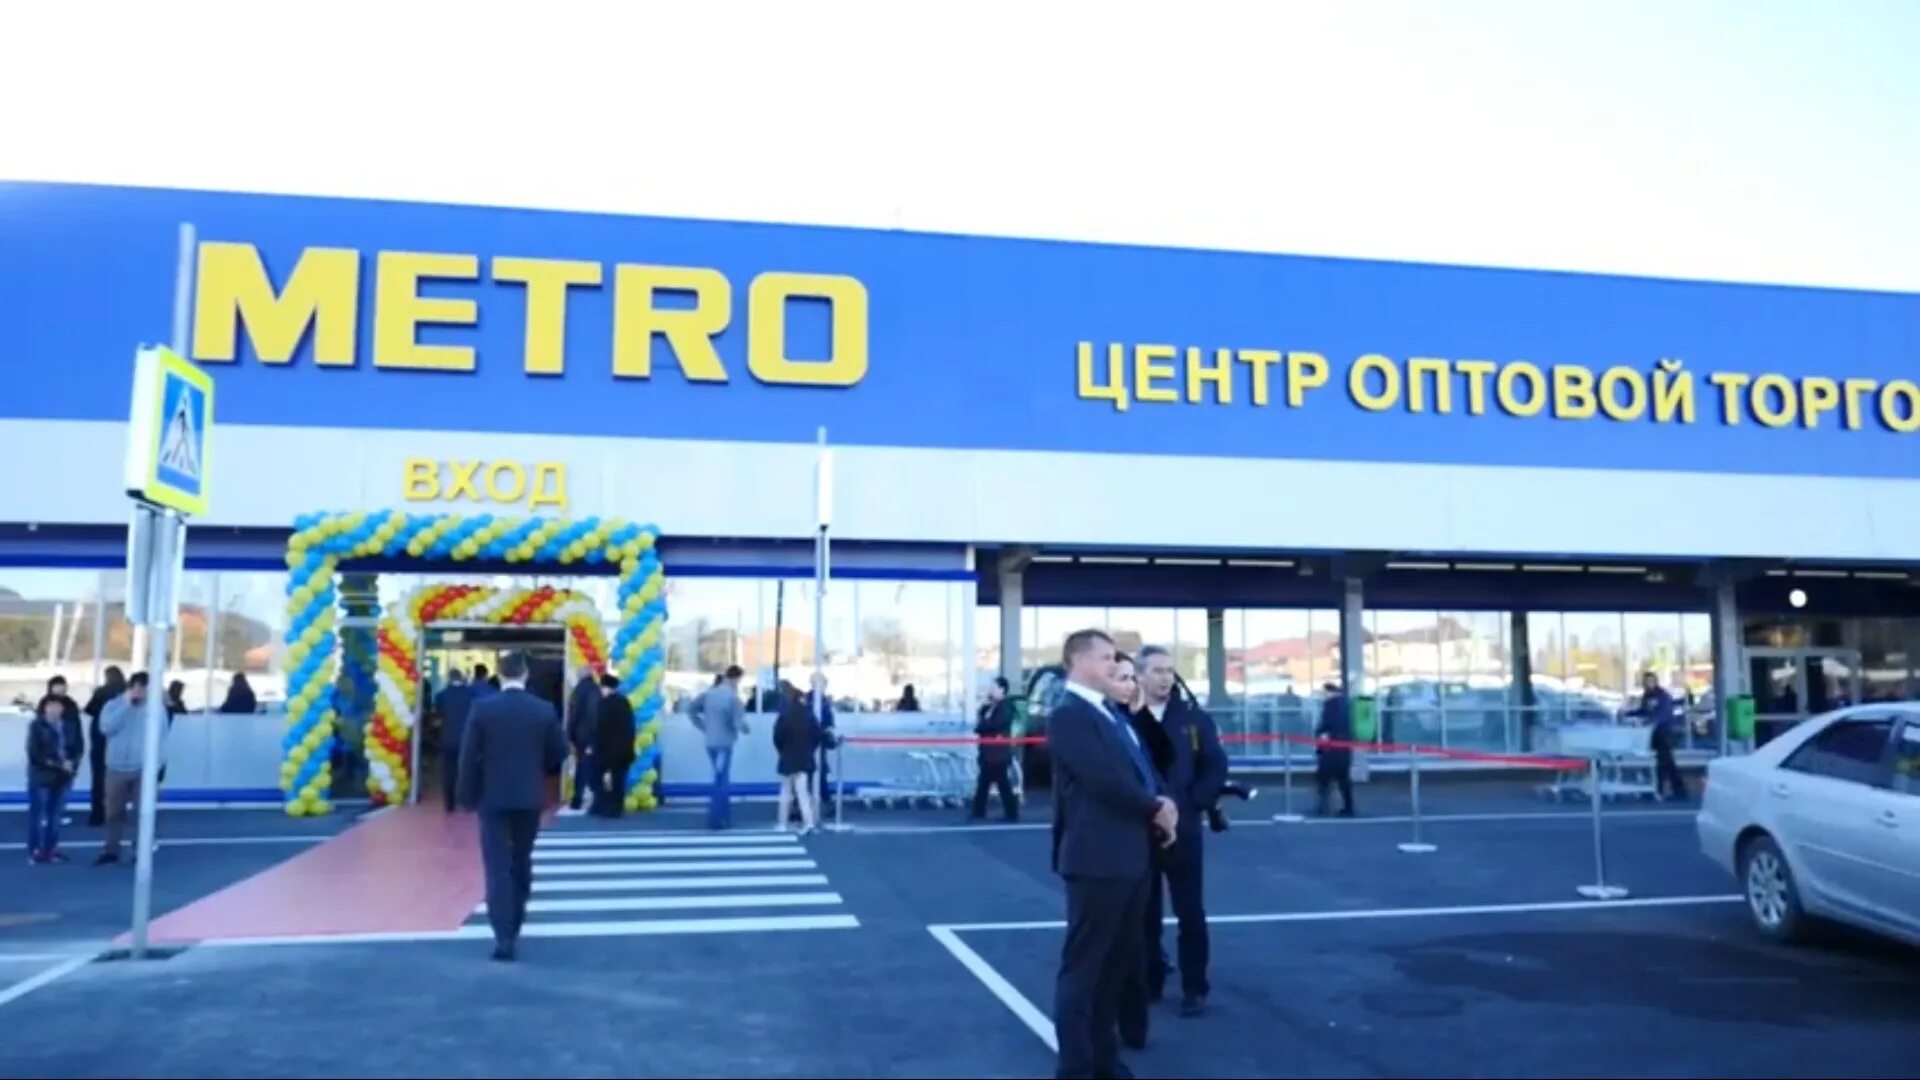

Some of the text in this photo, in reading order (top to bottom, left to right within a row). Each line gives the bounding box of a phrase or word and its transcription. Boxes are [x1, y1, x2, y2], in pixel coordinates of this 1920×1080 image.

[193, 240, 869, 386] METRO
[1077, 340, 1920, 433] ЦЕНТР ОПТОВОЙ ТОРГО
[403, 457, 569, 510] ВХОД
